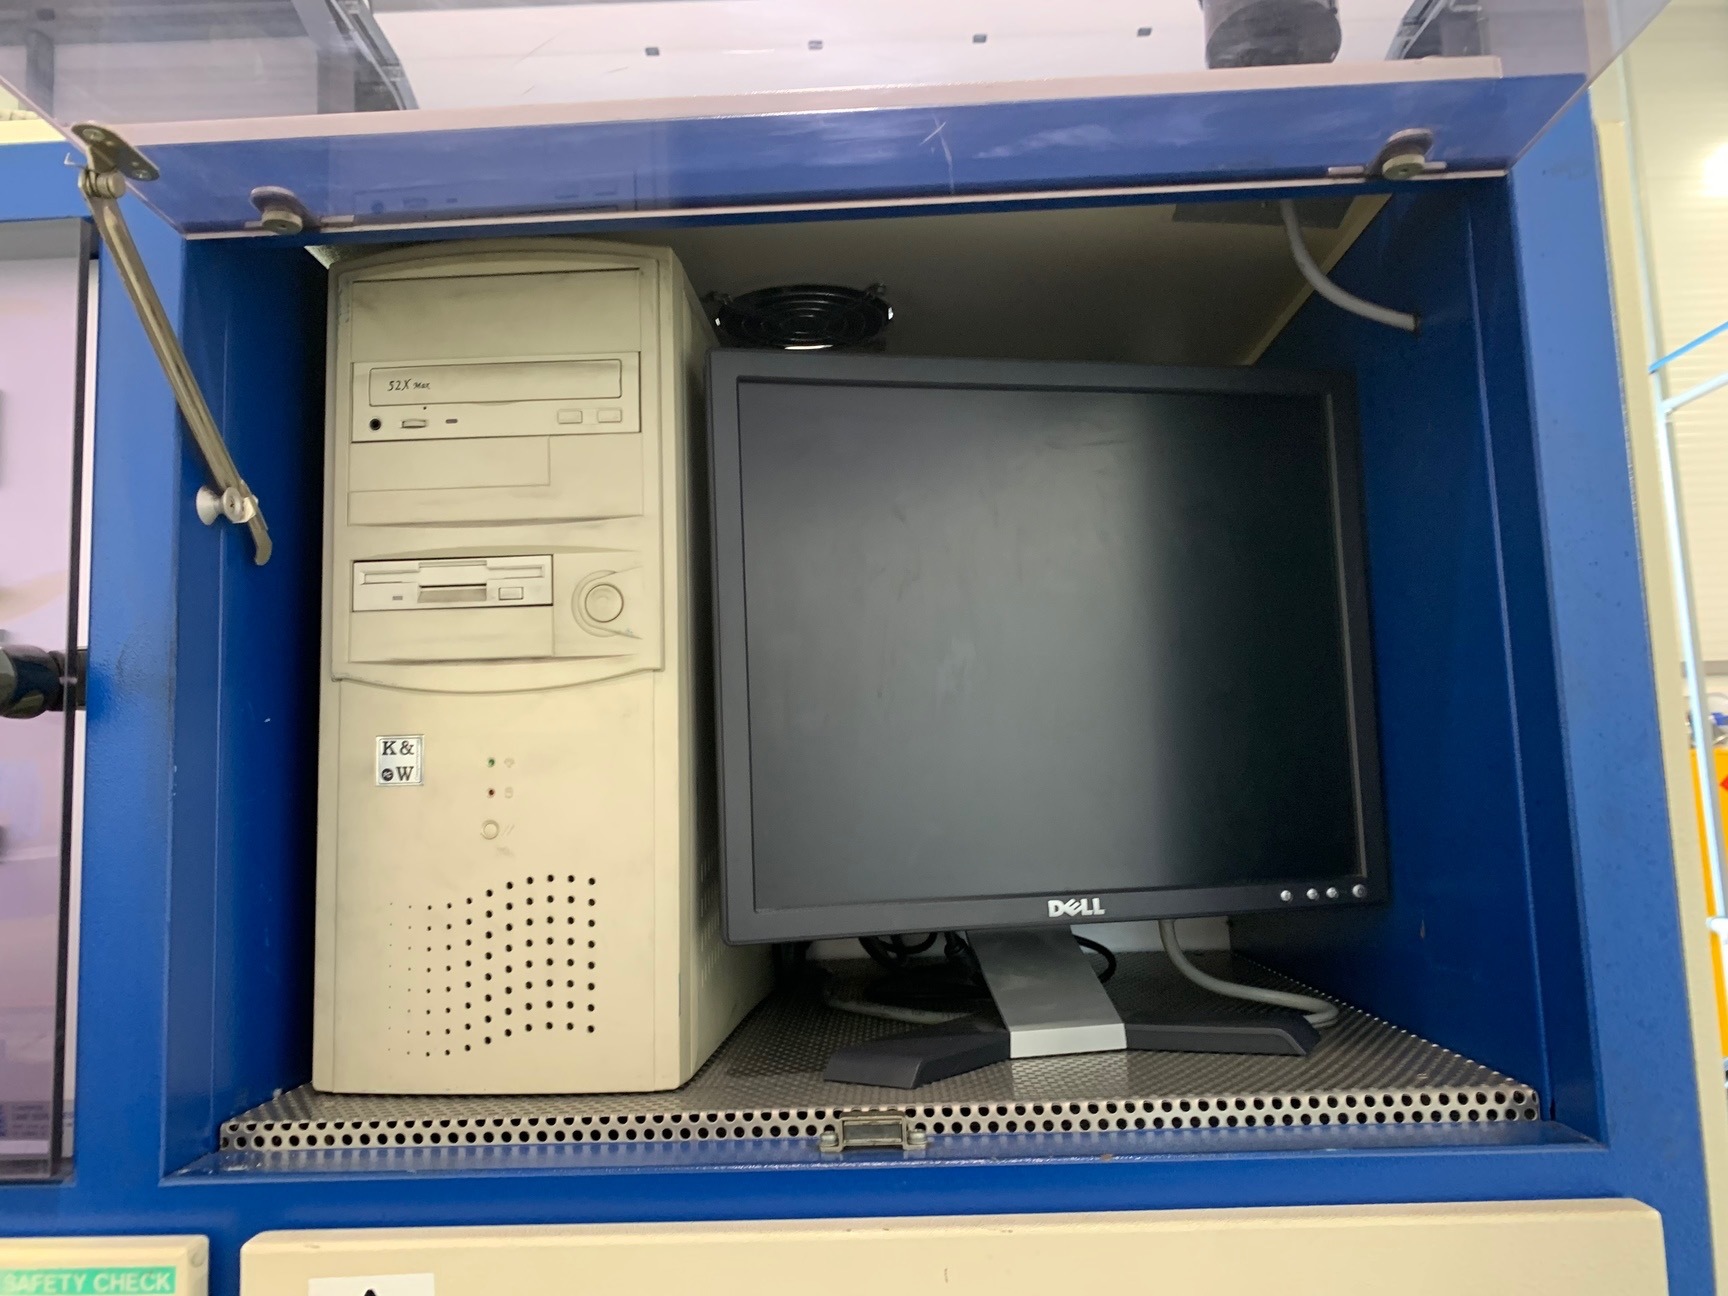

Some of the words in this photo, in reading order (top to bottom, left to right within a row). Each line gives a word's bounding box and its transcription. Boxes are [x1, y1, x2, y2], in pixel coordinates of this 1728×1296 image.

[387, 378, 411, 392] 52X
[1047, 897, 1106, 918] DELL
[4, 1273, 87, 1293] SAFETY
[93, 1272, 171, 1292] CHECK
